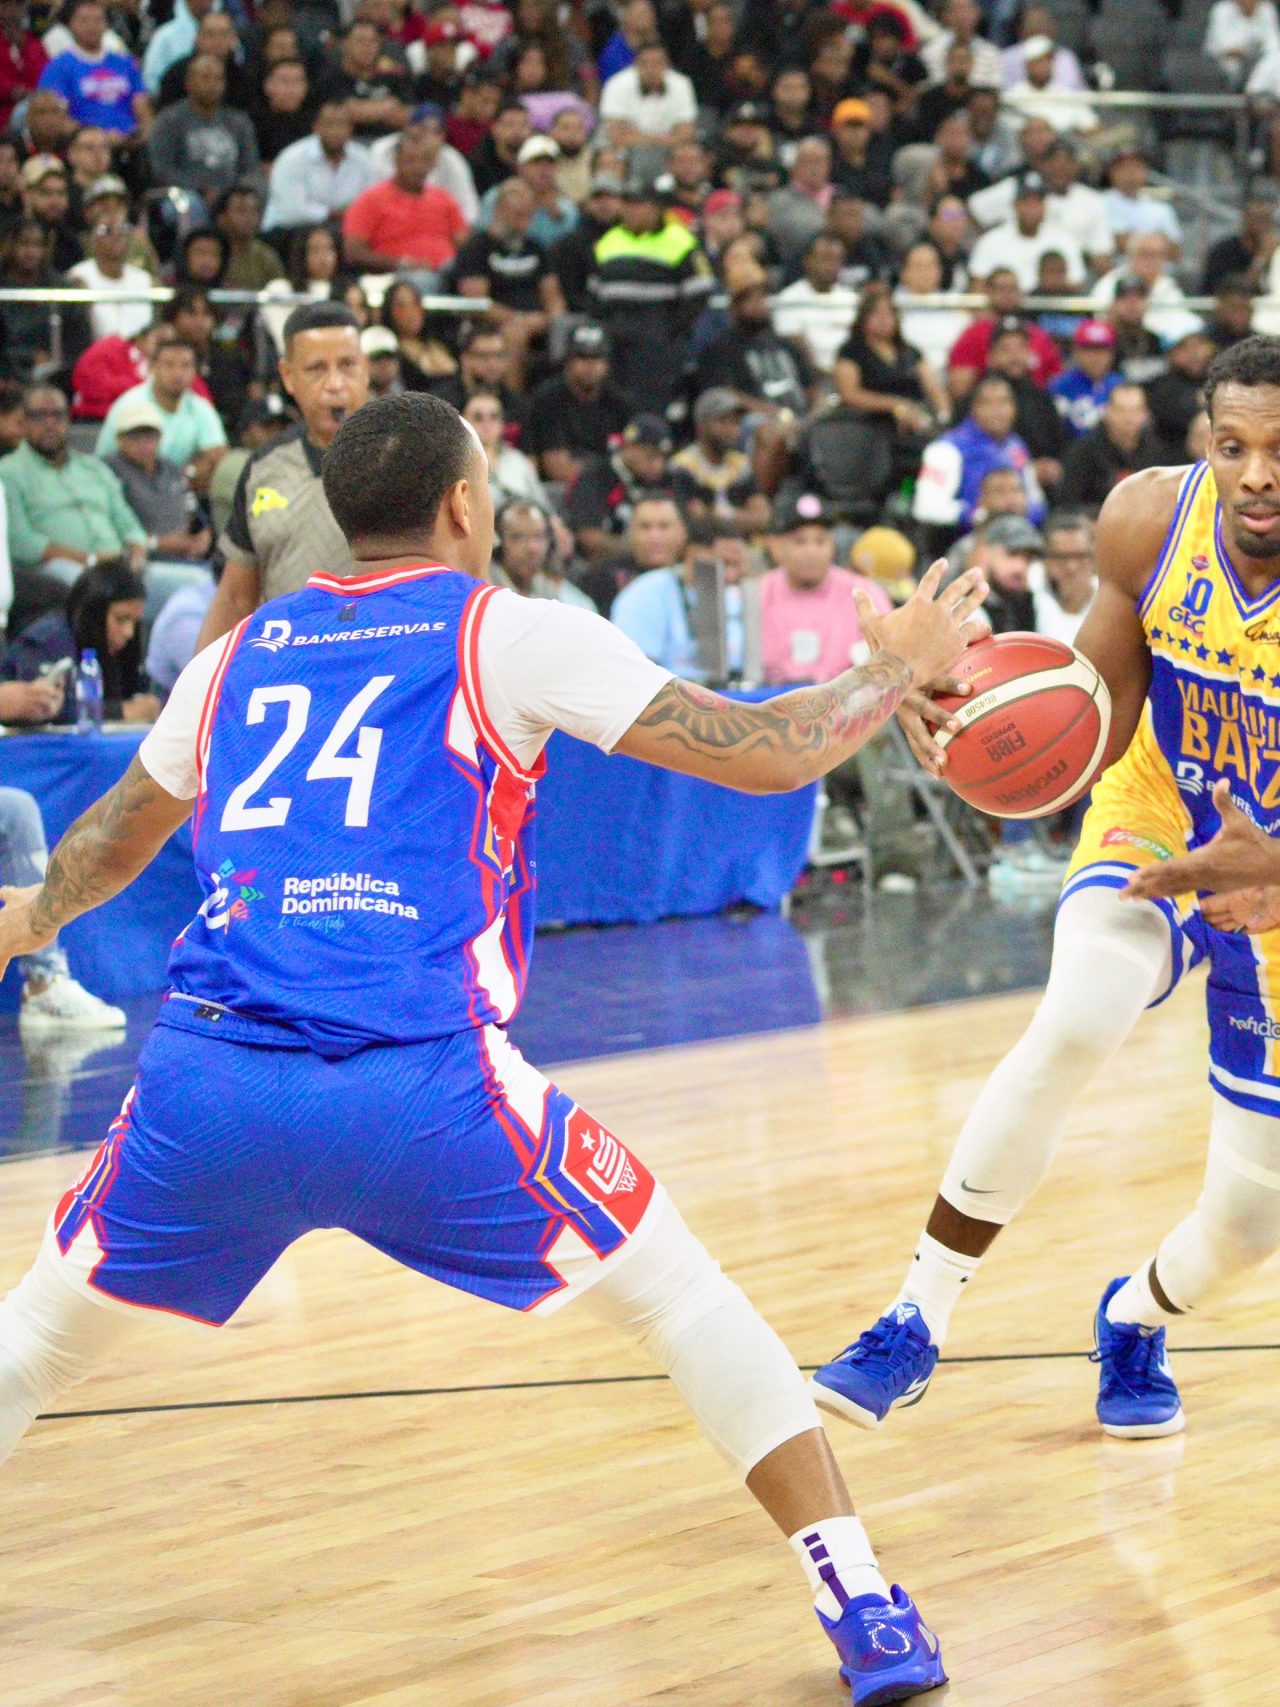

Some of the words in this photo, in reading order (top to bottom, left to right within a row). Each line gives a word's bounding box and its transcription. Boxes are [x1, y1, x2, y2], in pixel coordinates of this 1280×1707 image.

[291, 621, 447, 647] BANRESERVAS
[980, 722, 1017, 746] APPROVED
[985, 730, 1027, 763] FIBA
[220, 675, 396, 833] 24
[996, 760, 1069, 805] molten
[283, 872, 400, 897] República
[281, 892, 420, 920] Dominicana
